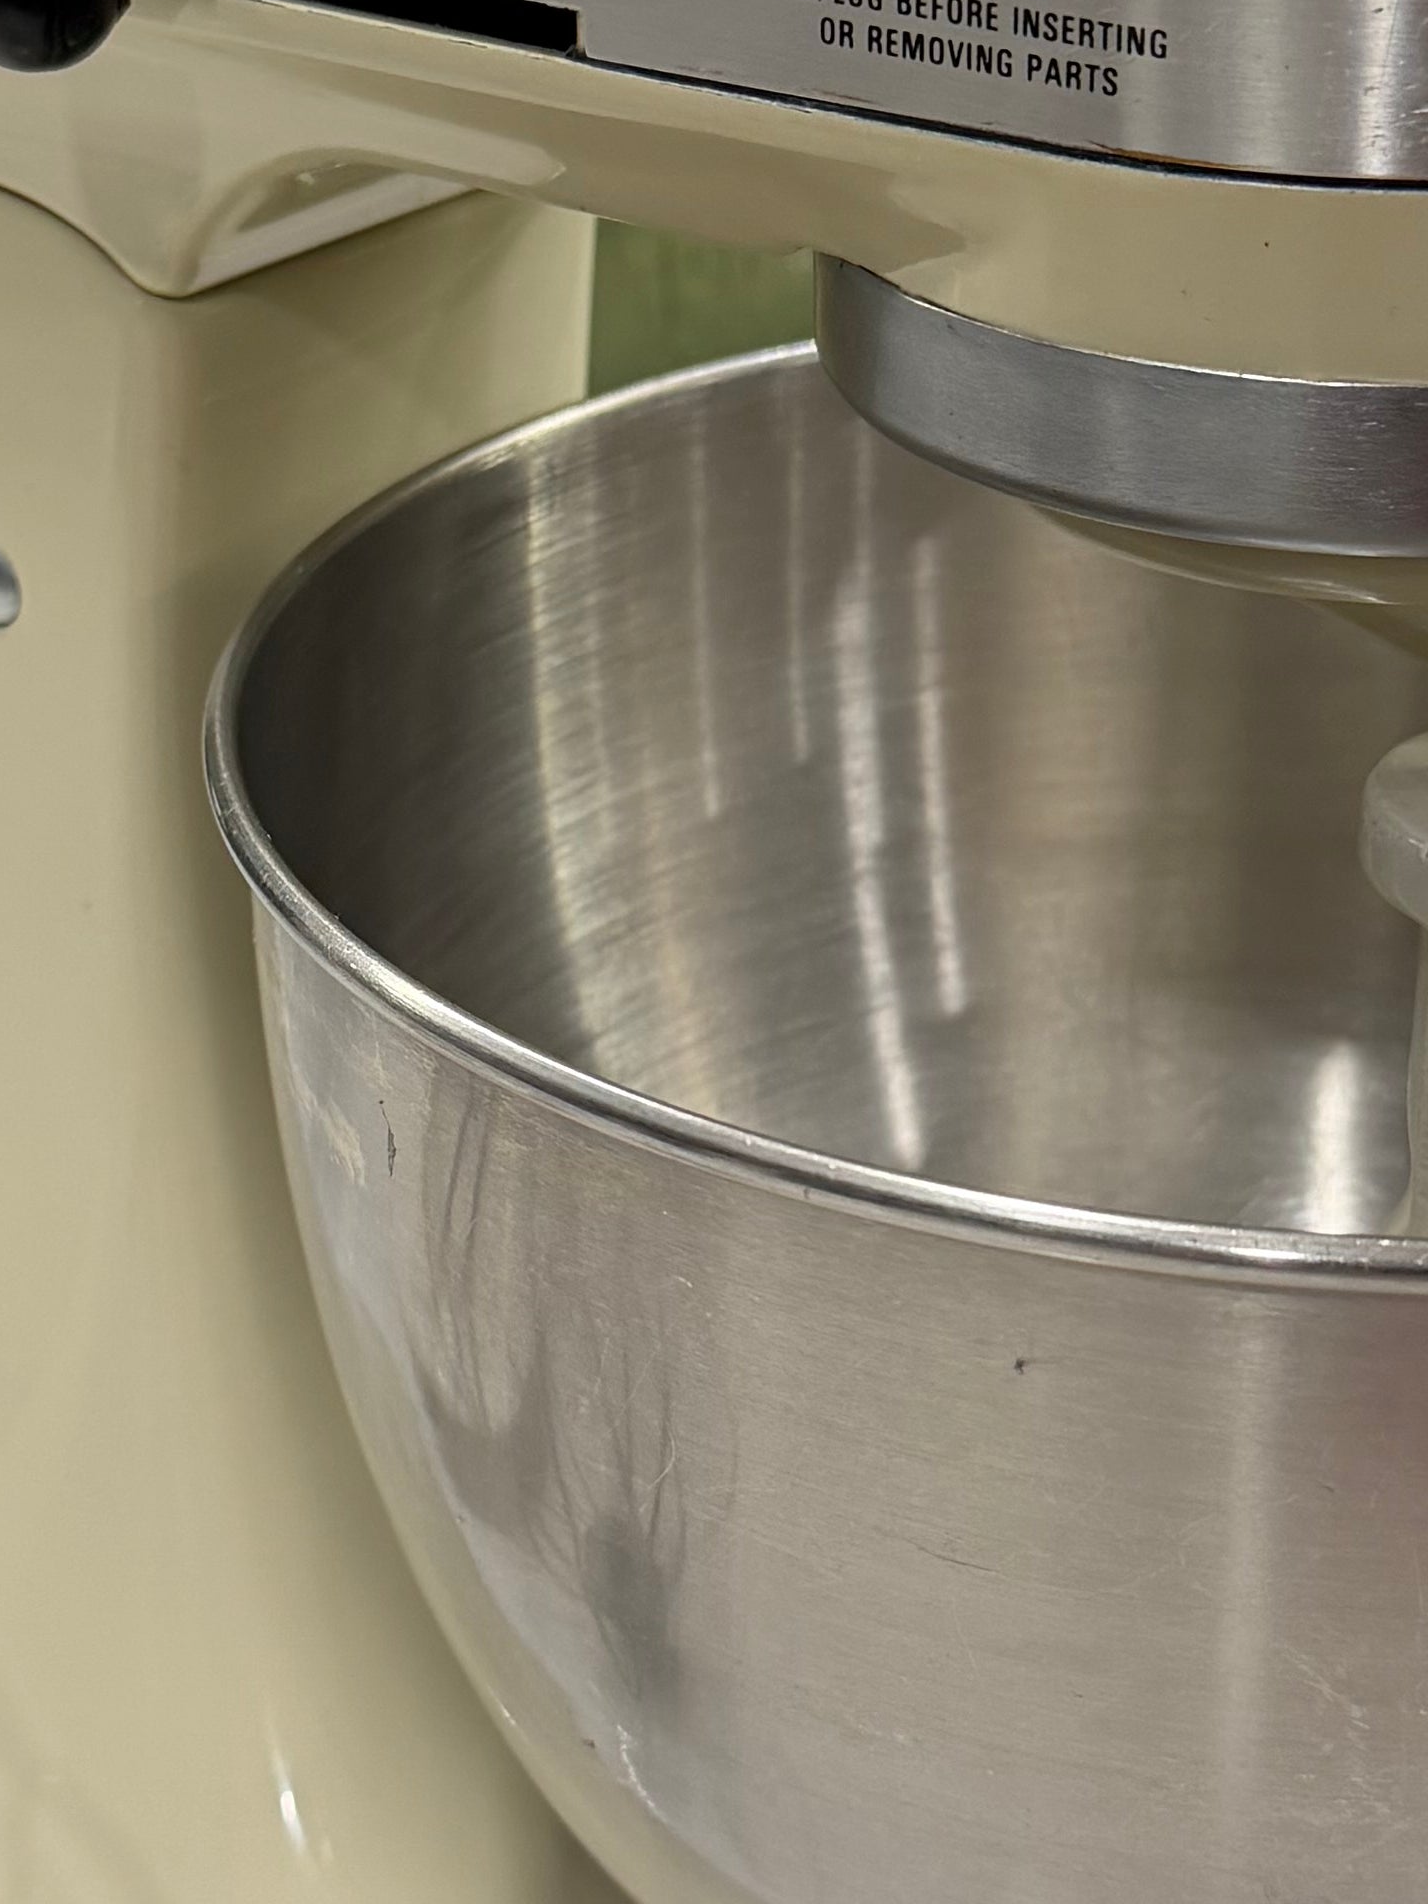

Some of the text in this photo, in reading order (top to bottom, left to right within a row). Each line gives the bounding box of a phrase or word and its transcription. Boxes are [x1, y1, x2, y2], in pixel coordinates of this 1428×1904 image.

[819, 16, 1119, 97] OR REMOVING PARTS
[1013, 6, 1169, 59] INSERTING
